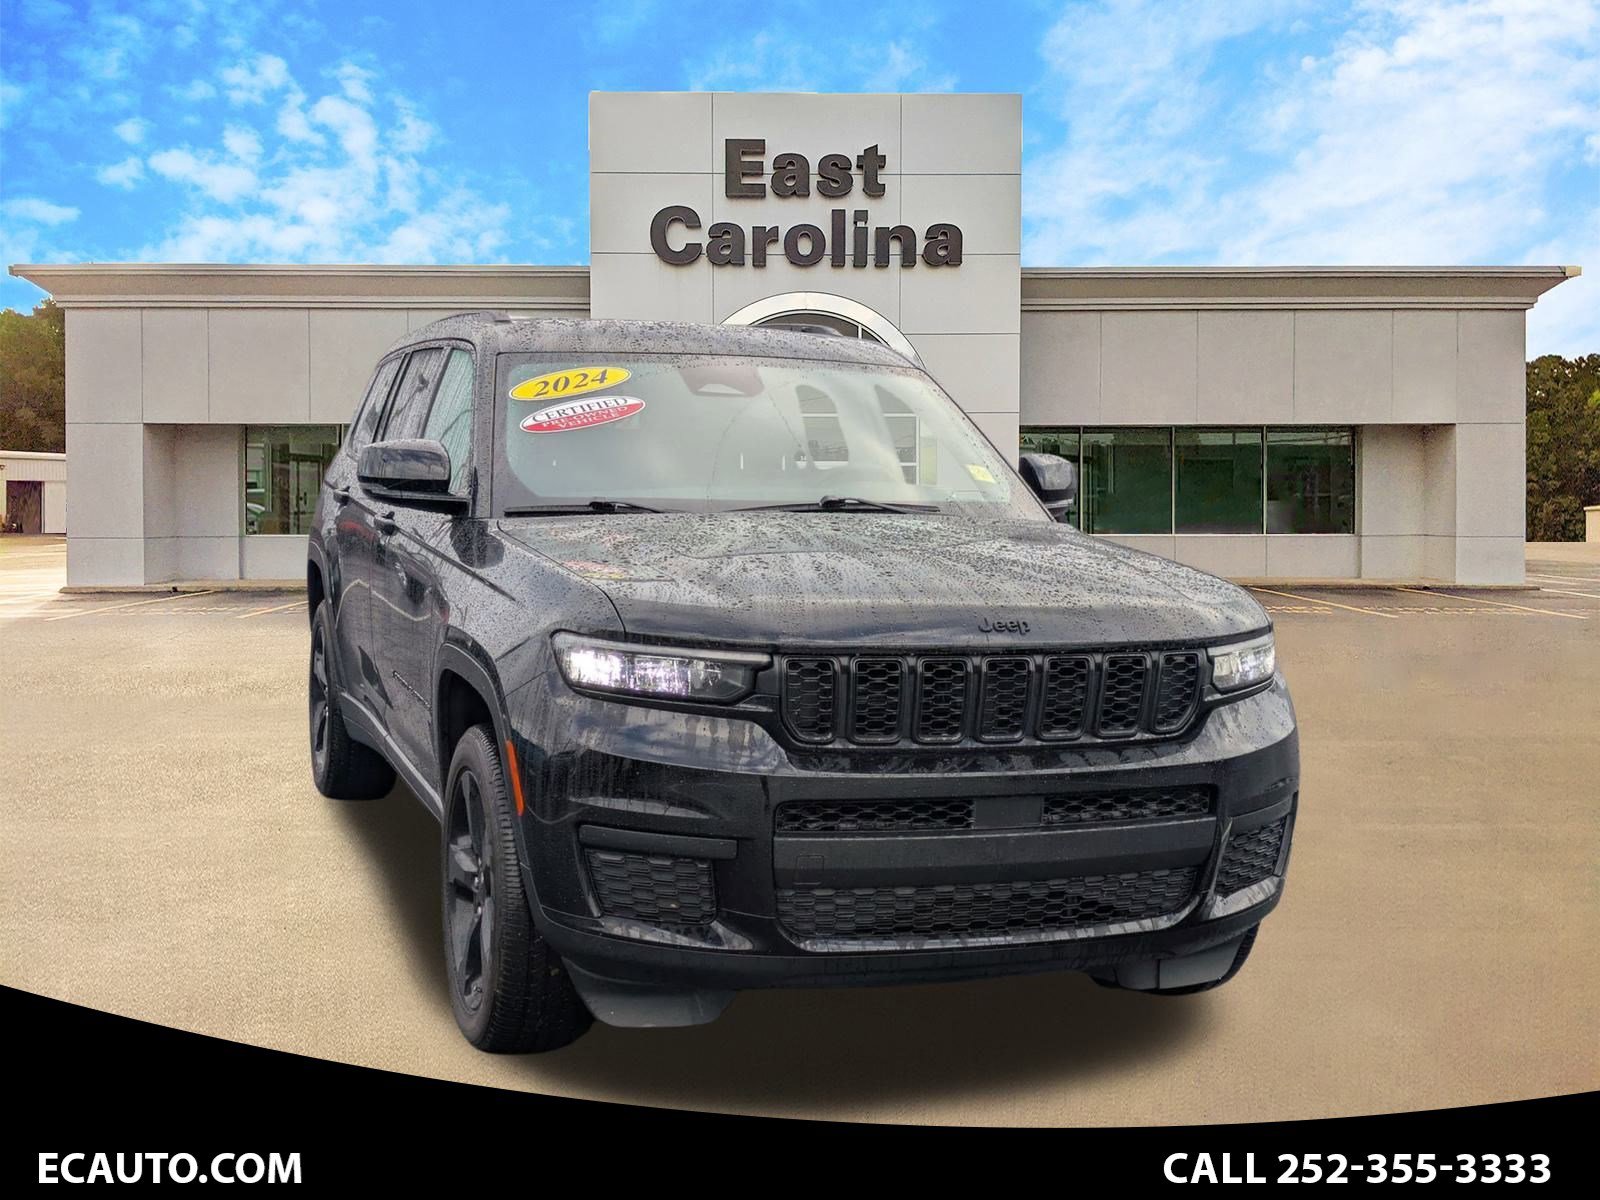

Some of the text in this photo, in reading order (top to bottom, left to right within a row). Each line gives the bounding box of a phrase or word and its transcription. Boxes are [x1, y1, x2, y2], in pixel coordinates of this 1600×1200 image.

[725, 139, 887, 198] East
[650, 205, 963, 268] Carolina
[534, 369, 608, 397] 2024
[532, 398, 628, 422] CERTIFIED
[558, 413, 620, 428] VEHICLE
[978, 617, 1031, 635] Jeep
